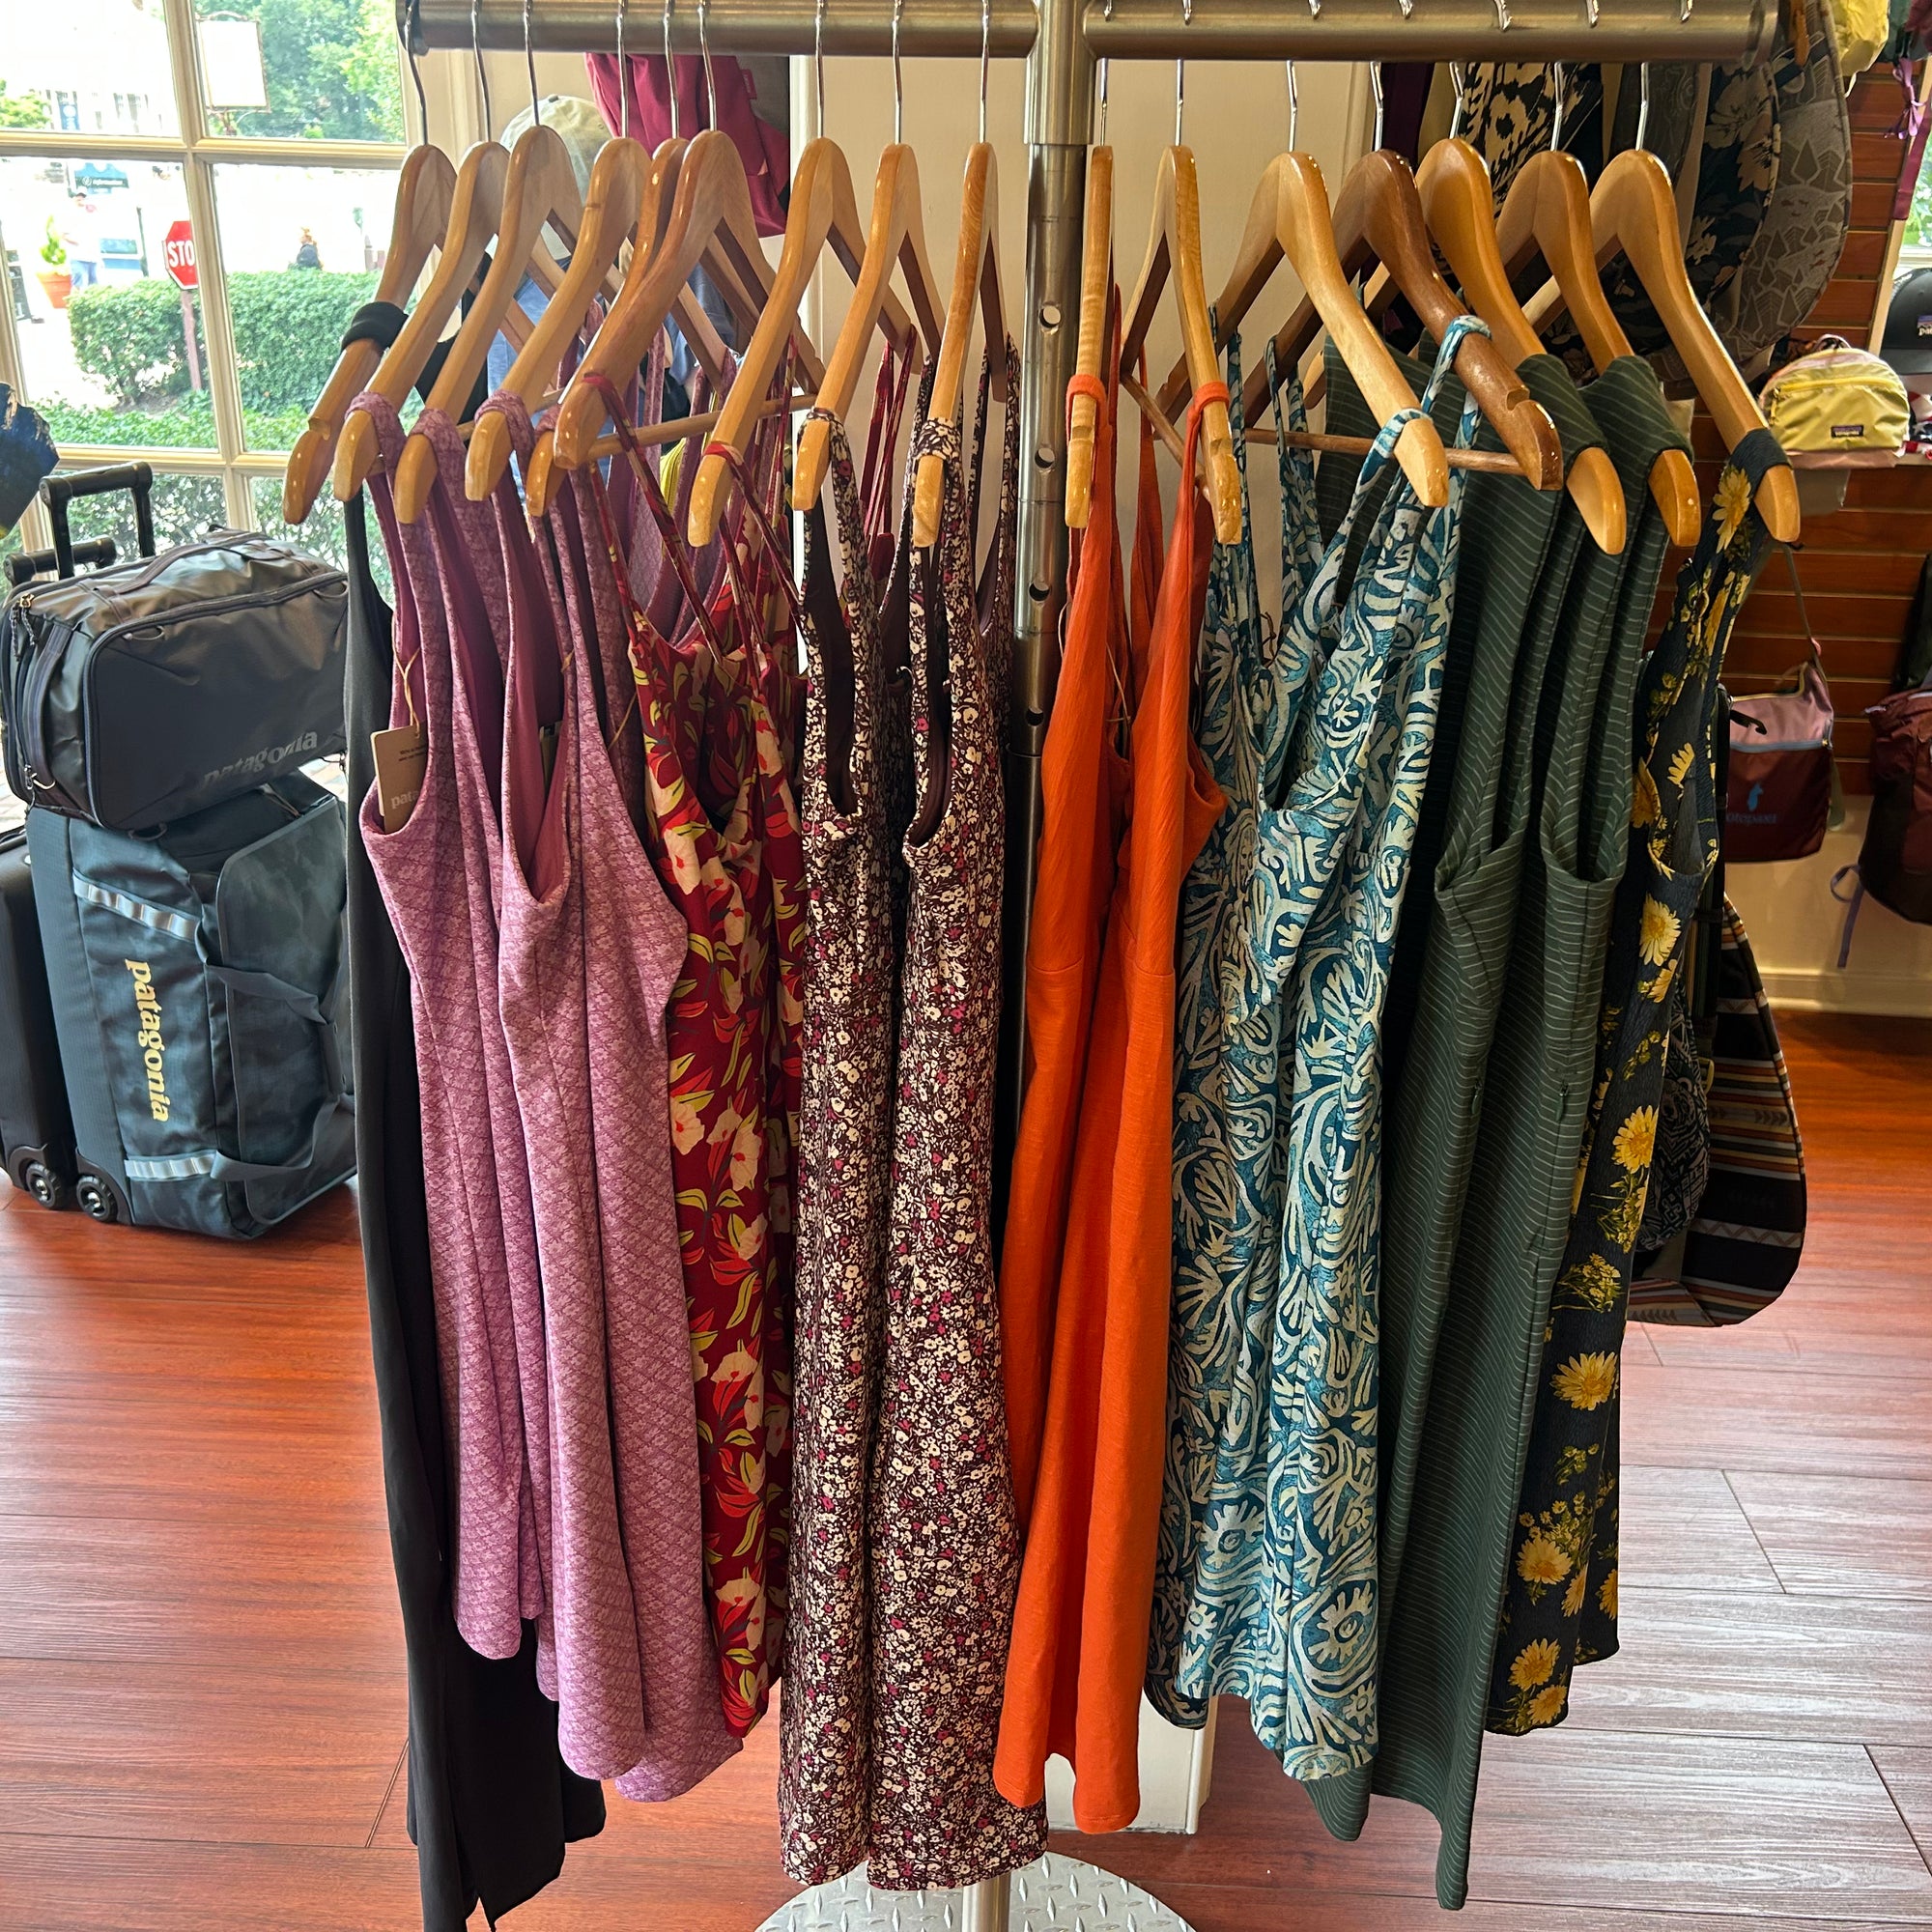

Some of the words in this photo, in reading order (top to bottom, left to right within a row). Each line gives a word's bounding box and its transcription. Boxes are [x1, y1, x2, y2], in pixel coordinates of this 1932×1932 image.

[167, 240, 196, 268] STO
[390, 790, 420, 810] pata
[125, 958, 171, 1122] patagonia
